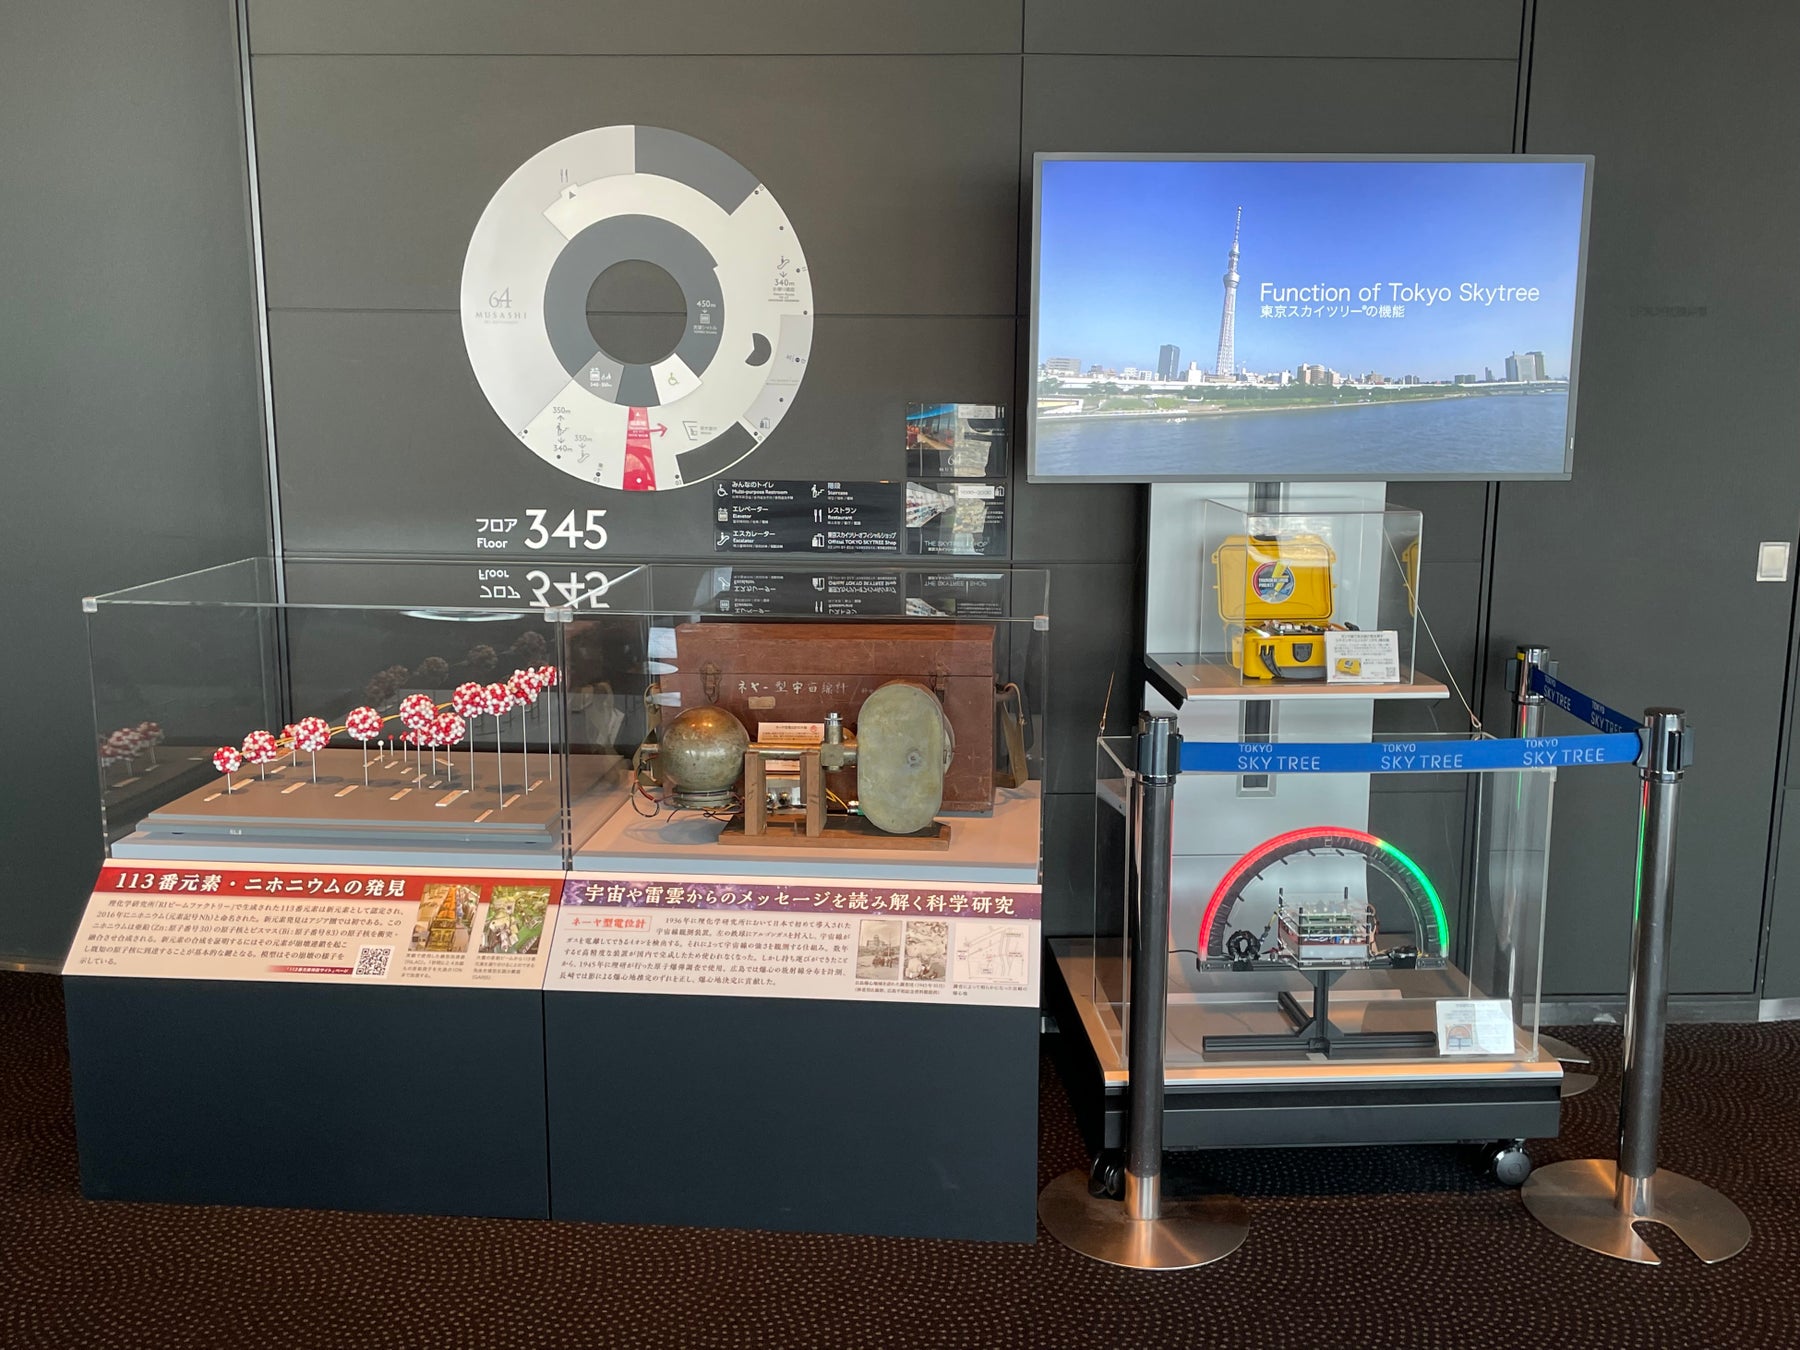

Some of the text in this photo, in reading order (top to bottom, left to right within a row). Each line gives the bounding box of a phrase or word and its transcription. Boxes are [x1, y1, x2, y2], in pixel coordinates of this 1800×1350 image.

[1260, 283, 1540, 306] Function of Tokyo Skytree
[475, 311, 528, 320] MUSASHI
[476, 518, 518, 533] フロア
[524, 509, 607, 550] 345
[477, 538, 508, 548] Floor
[1239, 744, 1273, 753] TOKYO
[1383, 743, 1416, 752] TOKYO
[1524, 739, 1558, 748] TOKYO
[115, 873, 406, 897] 113番元素・ニホニウムの発見
[584, 884, 1015, 914] 宇宙や雷雲からのメッセージを読み解く科学研究
[572, 918, 646, 929] ネーヤ型電位計
[80, 957, 117, 965] 示している。
